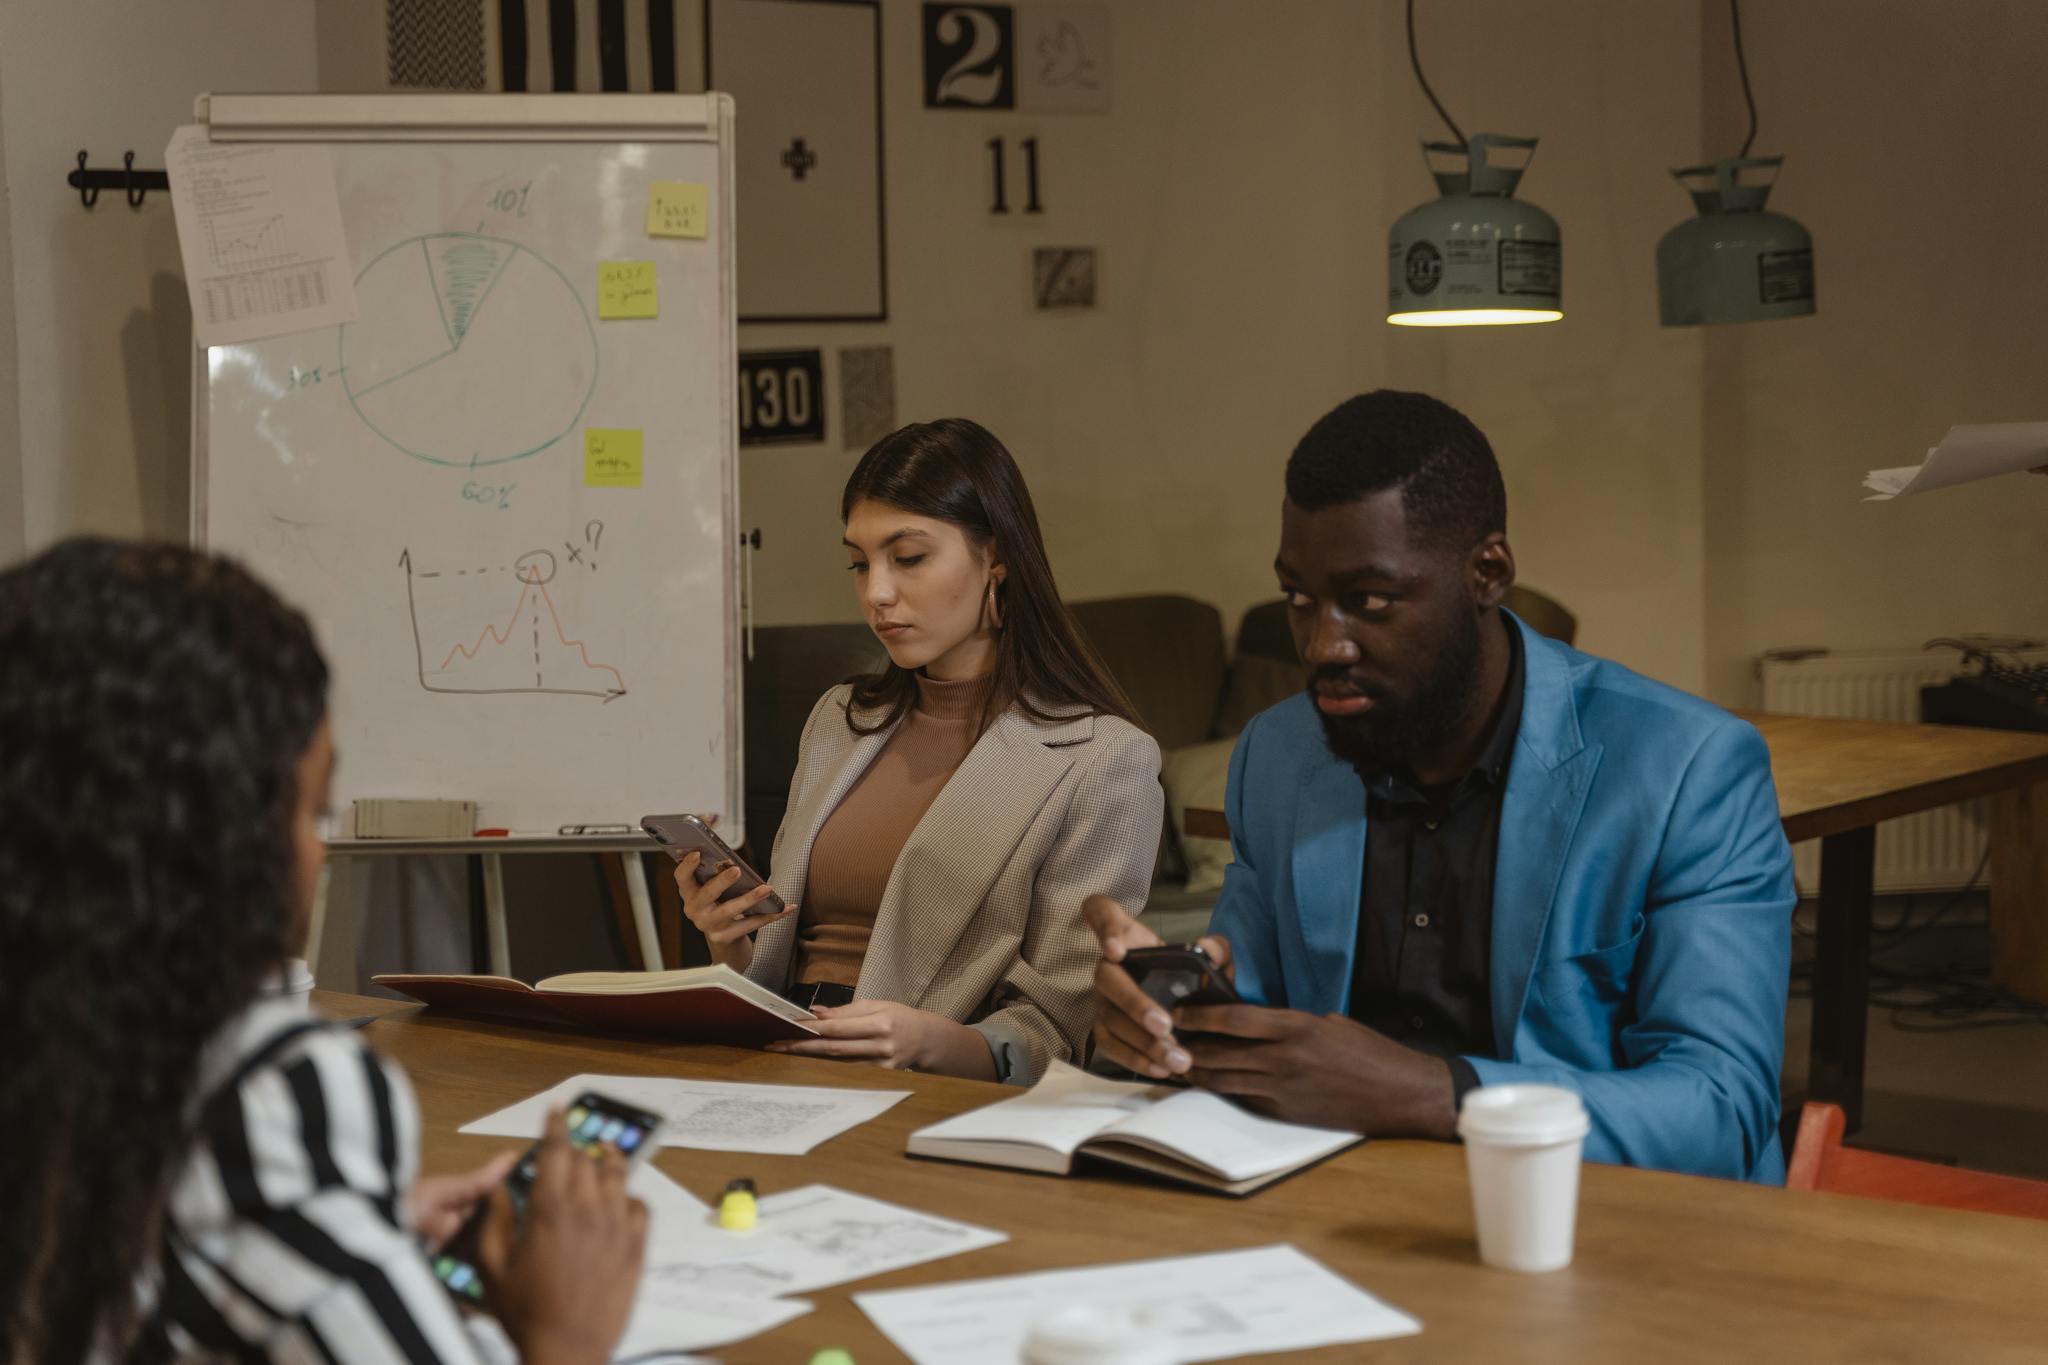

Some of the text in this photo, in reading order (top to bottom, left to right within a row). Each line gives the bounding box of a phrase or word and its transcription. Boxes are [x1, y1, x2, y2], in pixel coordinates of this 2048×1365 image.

[936, 7, 1003, 105] 2
[986, 135, 1046, 215] 11
[462, 480, 518, 510] 60%
